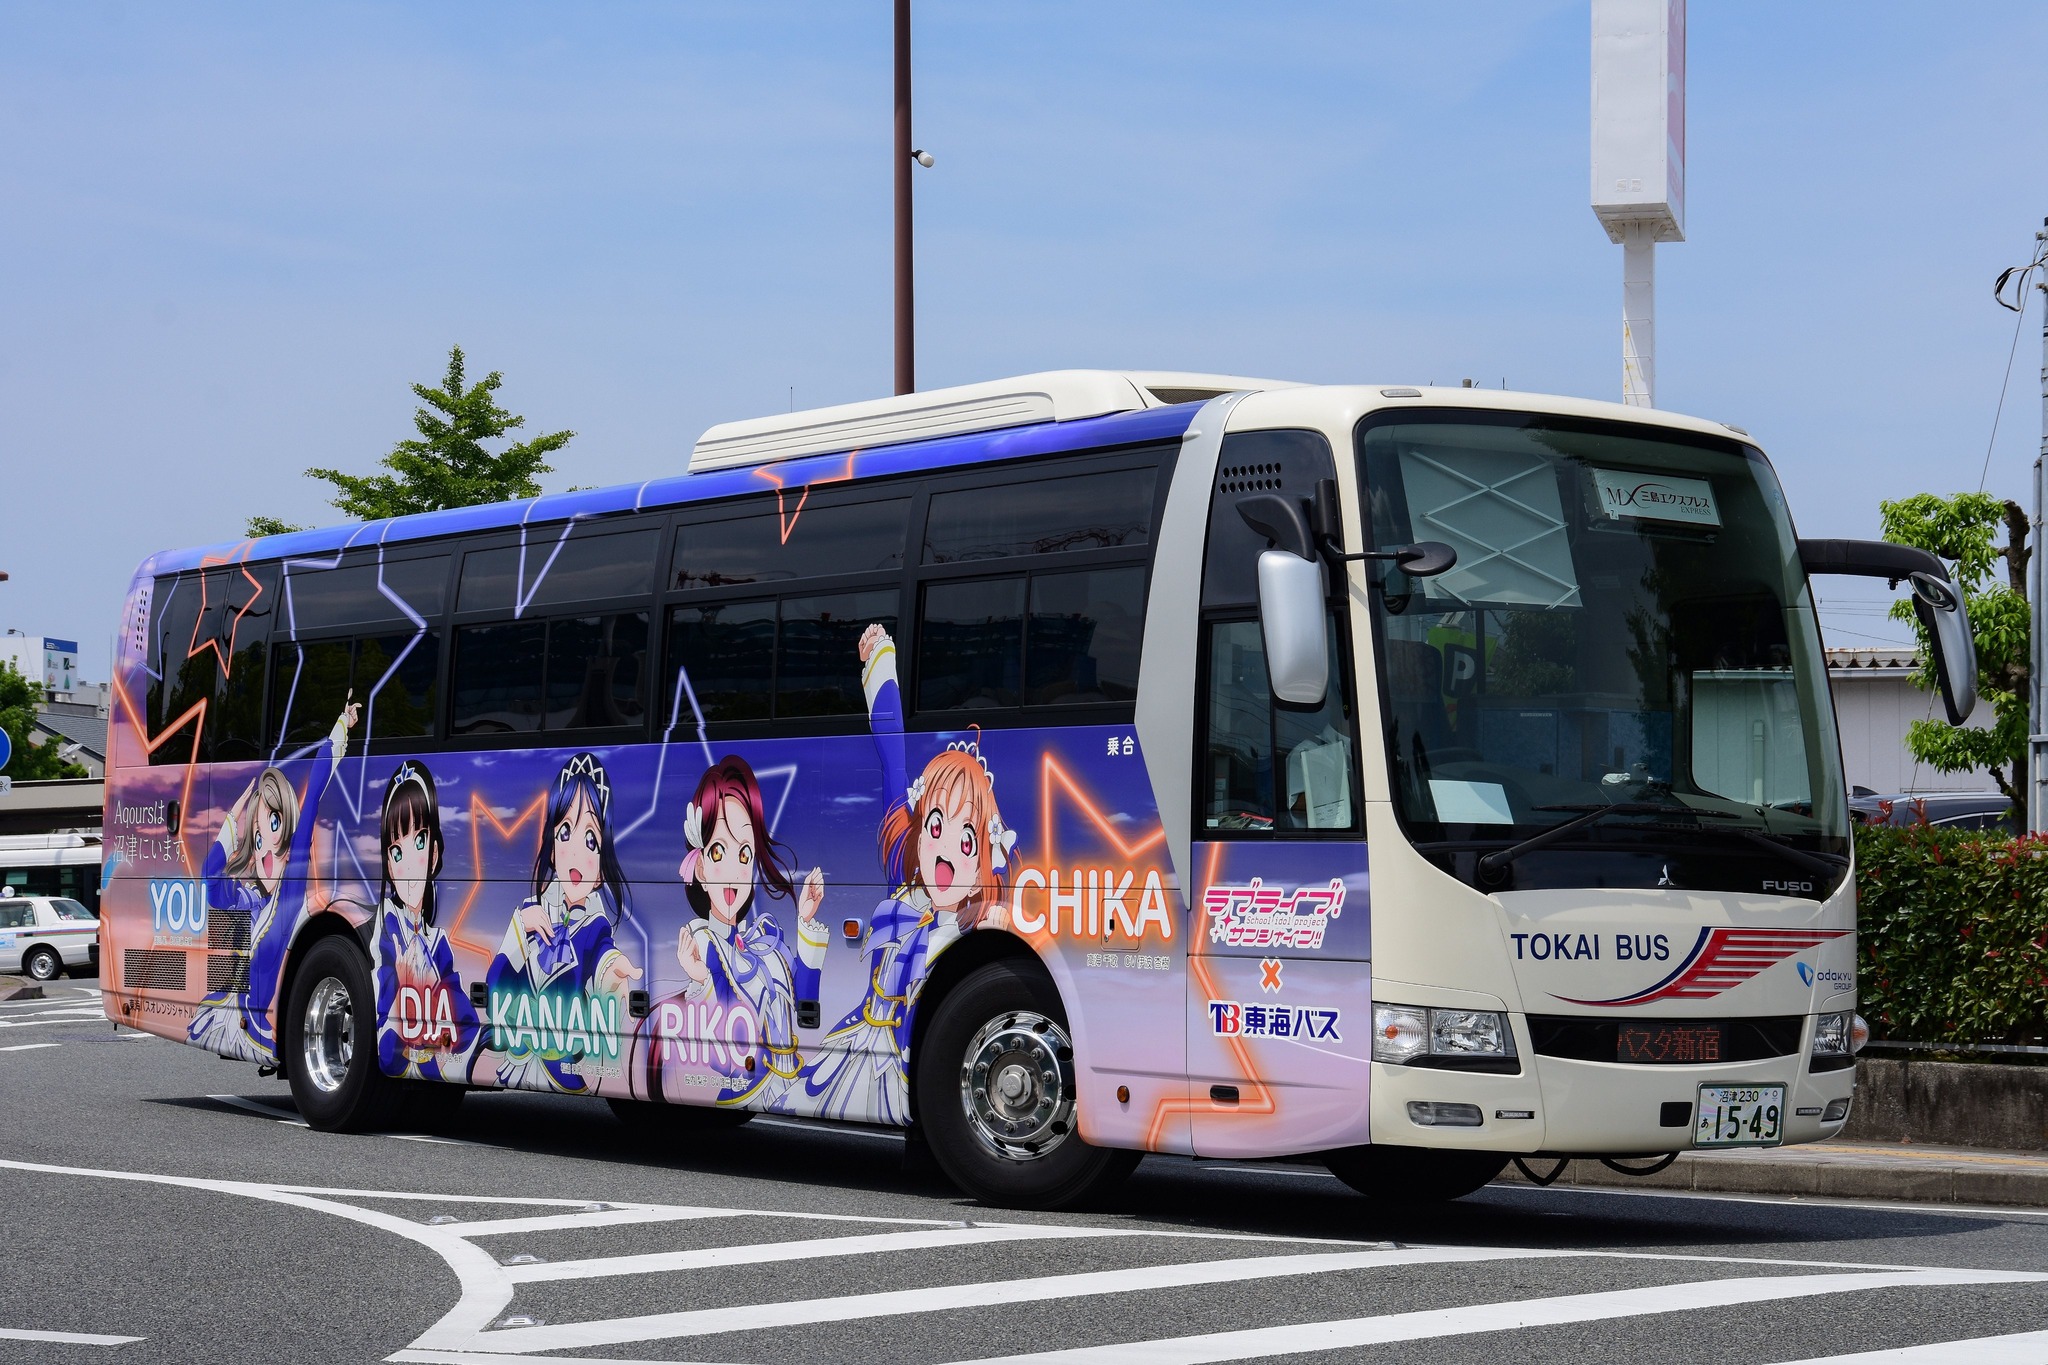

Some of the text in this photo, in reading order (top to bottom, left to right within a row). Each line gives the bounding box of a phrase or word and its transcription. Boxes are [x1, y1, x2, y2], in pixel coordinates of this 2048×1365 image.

[1641, 490, 1710, 508] 三島エクスプレス
[1681, 506, 1712, 516] EXPRESS
[1451, 651, 1476, 692] P
[1106, 735, 1135, 757] 乗合
[114, 799, 165, 828] Aqoursは
[113, 834, 187, 864] 沼津にいます。
[1762, 880, 1813, 892] FUSO
[150, 882, 207, 931] YOU
[1012, 868, 1172, 938] CHIKA
[1246, 915, 1326, 927] School idol project
[1510, 933, 1670, 961] TOKAI BUS
[400, 986, 458, 1042] DIA
[492, 991, 618, 1057] KANAN
[1244, 1006, 1340, 1040] 東海バス
[660, 1003, 758, 1067] RIKO
[1700, 1104, 1779, 1140] あ 15-49
